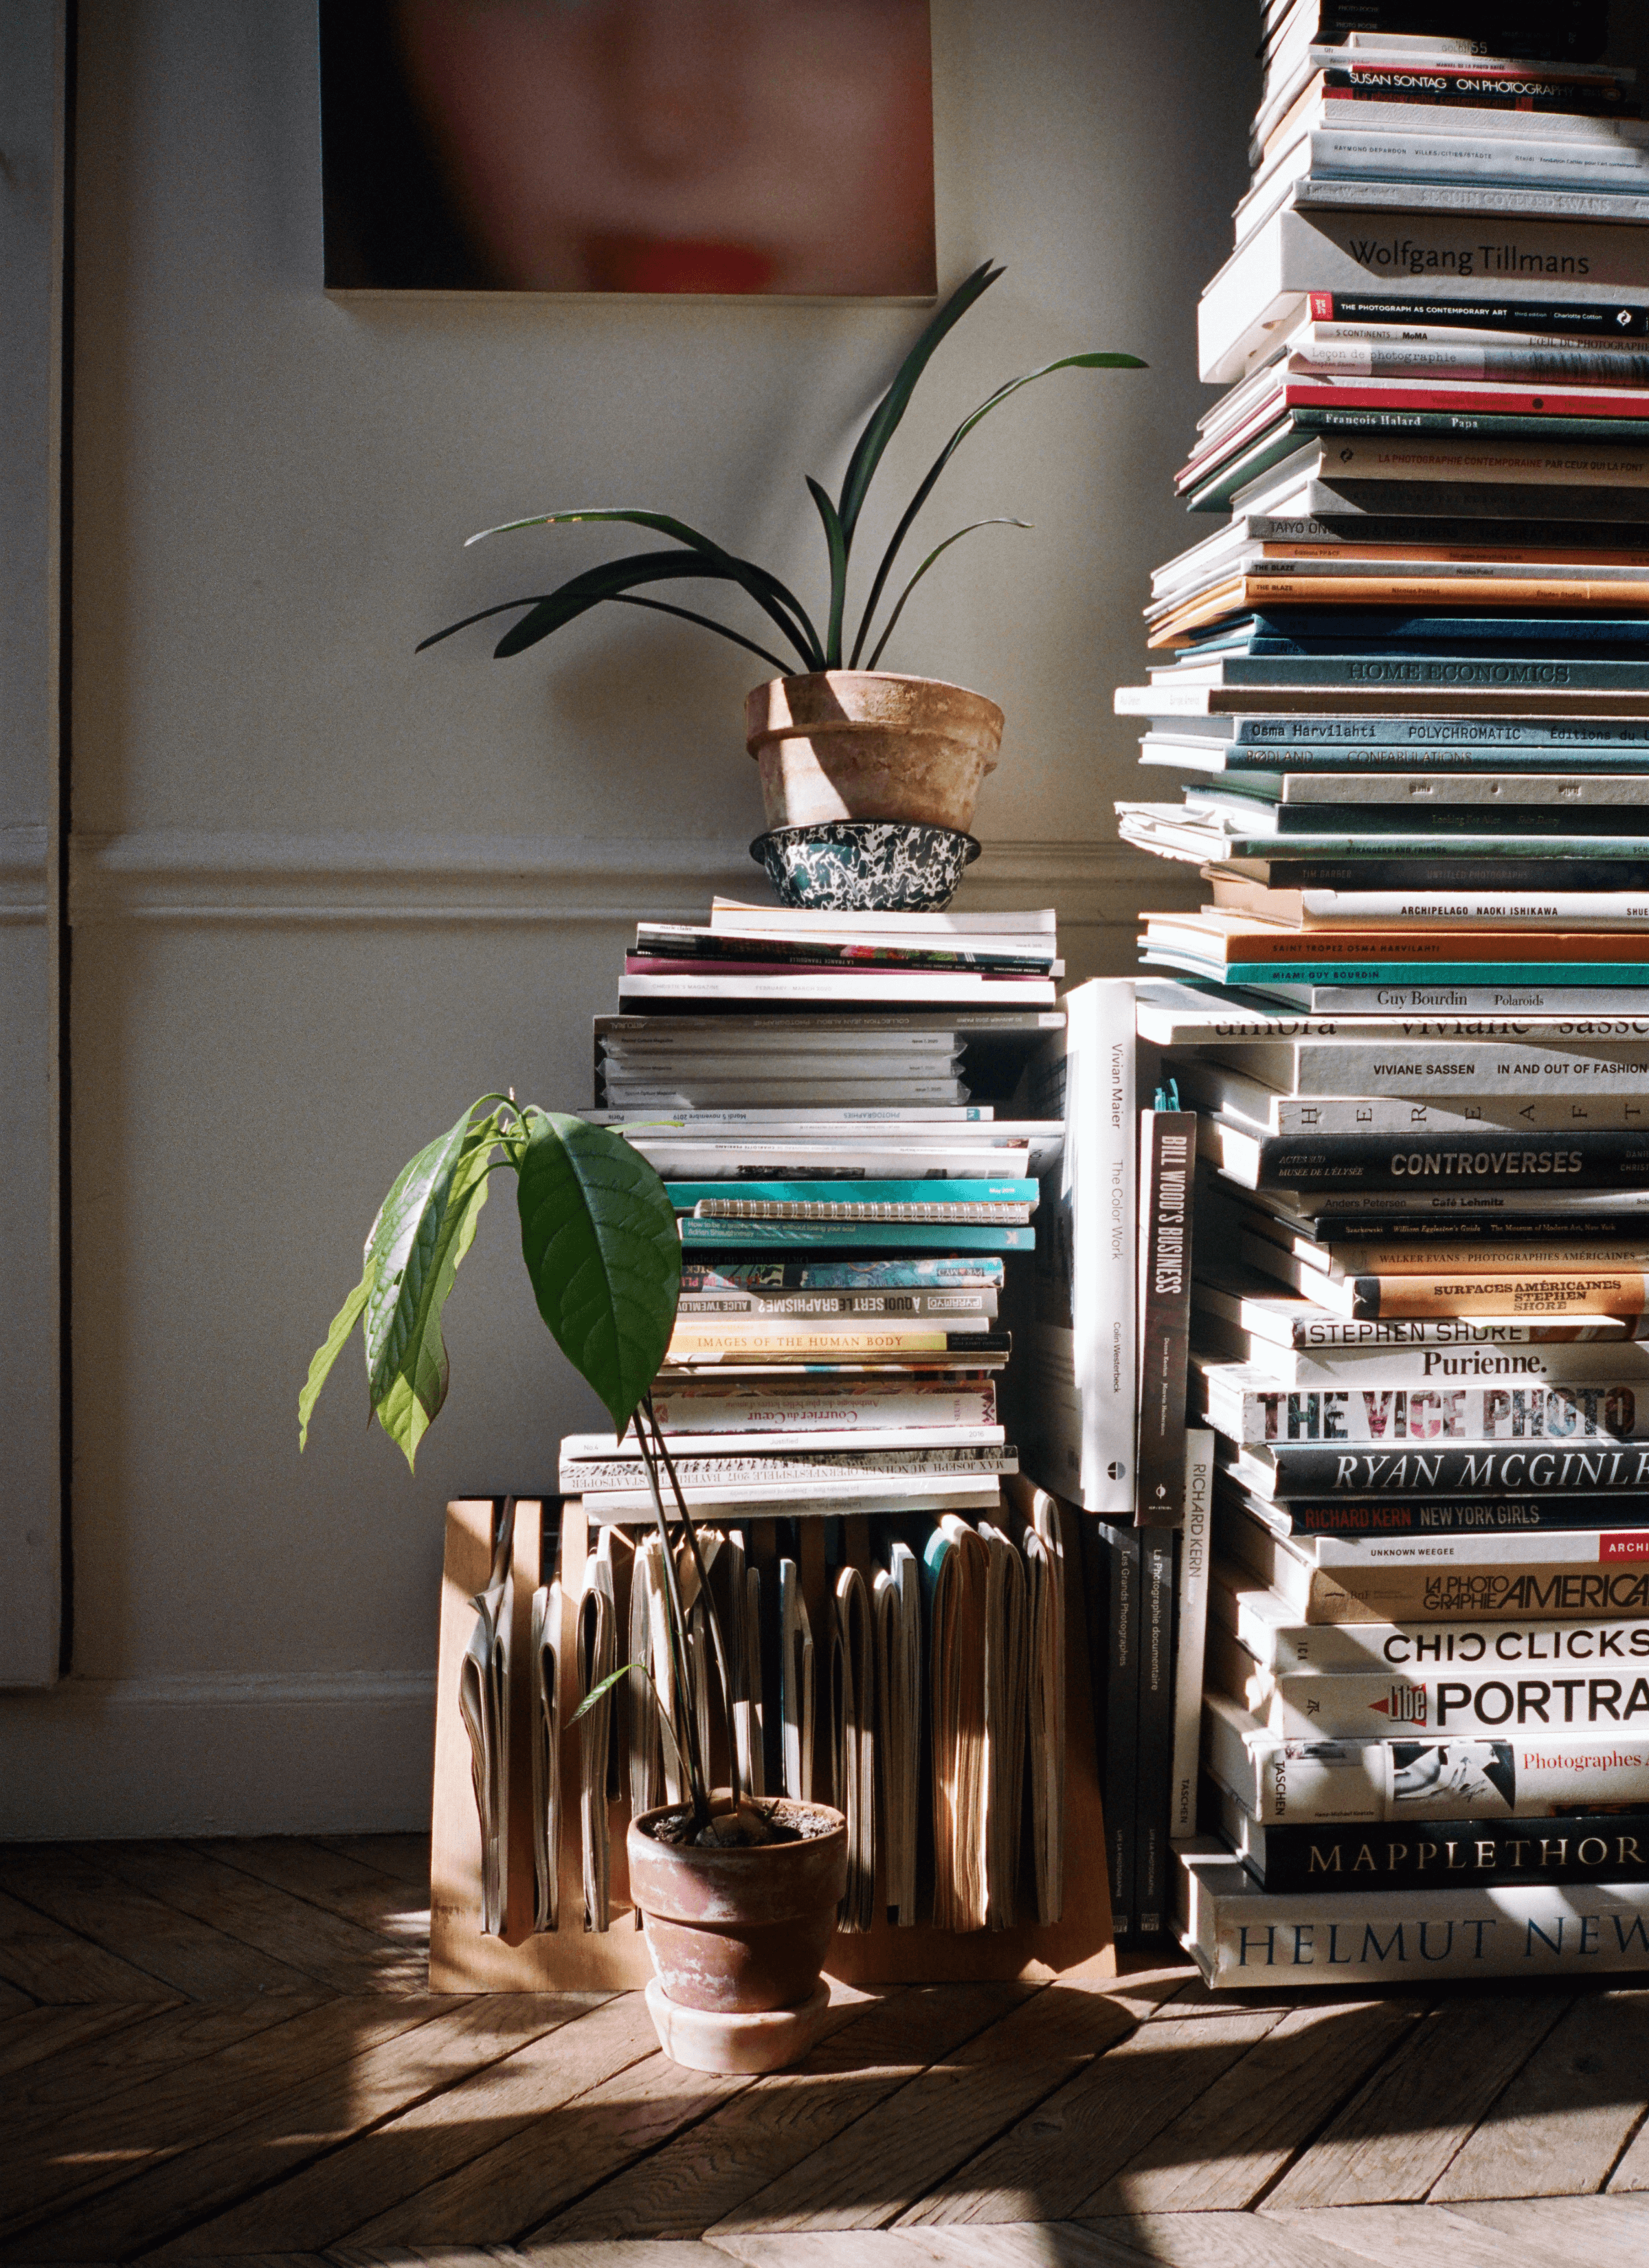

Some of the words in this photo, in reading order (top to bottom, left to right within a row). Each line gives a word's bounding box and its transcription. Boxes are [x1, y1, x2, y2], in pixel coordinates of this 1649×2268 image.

[1349, 72, 1391, 87] SUSAN
[1393, 75, 1446, 89] SONTAG
[1456, 78, 1480, 91] ON
[1482, 80, 1575, 97] PHOTOGRAPHY
[1349, 239, 1473, 275] Wolfgang
[1479, 246, 1590, 275] Tillmans
[1358, 304, 1411, 313] PHOTOGRAPH
[1426, 307, 1490, 315] CONTEMPORARY
[1312, 348, 1347, 361] Leçon
[1351, 349, 1365, 359] de
[1370, 350, 1457, 364] photographie
[1325, 414, 1376, 426] François
[1380, 414, 1422, 427] Halard
[1451, 416, 1479, 429] Papa
[1378, 454, 1390, 463] LA
[1391, 454, 1463, 466] PHOTOGRAPHIE
[1463, 456, 1543, 468] CONTEMPORAINE
[1545, 459, 1562, 469] PAR
[1564, 460, 1589, 470] CEUX
[1590, 460, 1604, 471] QUI
[1606, 461, 1618, 471] LA
[1619, 461, 1644, 472] FONT
[1270, 521, 1305, 534] TAIYO
[1346, 662, 1420, 680] HOME
[1425, 664, 1570, 683] ECONOMICS
[1251, 724, 1286, 737] Osma
[1293, 724, 1377, 738] Harvilahti
[1407, 726, 1522, 741] POLYCHROMATIC
[1550, 724, 1611, 741] Éditions
[1619, 729, 1637, 740] du
[1246, 751, 1314, 764] RØDLAND
[1347, 751, 1472, 764] CONFABULATIONS
[1400, 906, 1469, 915] ARCHIPELAGO
[1477, 906, 1506, 915] NAOKI
[1510, 907, 1558, 916] ISHIKAWA
[1626, 907, 1649, 916] SHUE
[1272, 944, 1303, 953] SAINT
[1305, 944, 1343, 953] TROPEZ
[1347, 944, 1376, 953] OSMA
[1380, 944, 1440, 953] HARVILAHTI
[1272, 971, 1305, 979] MIAMI
[1308, 971, 1330, 979] GUY
[1333, 970, 1380, 979] BOURDIN
[1377, 990, 1407, 1010] Guy
[1411, 990, 1468, 1006] Bourdin
[1494, 994, 1545, 1006] Polaroids
[1111, 1043, 1123, 1085] Vivian
[1373, 1064, 1423, 1076] VIVIANE
[1425, 1064, 1475, 1075] SASSEN
[1497, 1064, 1512, 1074] IN
[1514, 1063, 1540, 1074] AND
[1544, 1063, 1569, 1074] OUT
[1573, 1063, 1591, 1074] OF
[1593, 1063, 1648, 1074] FASHION
[1111, 1087, 1123, 1129] Maier
[1160, 1135, 1187, 1166] BILL
[1112, 1159, 1124, 1185] The
[1391, 1150, 1583, 1176] CONTROVERSES
[1111, 1188, 1124, 1221] Color
[1158, 1170, 1187, 1224] WOOD'S
[1111, 1223, 1124, 1260] Work
[1155, 1226, 1184, 1293] BUSINESS
[1380, 1252, 1424, 1264] WALKER
[1425, 1252, 1463, 1263] EVANS
[1468, 1252, 1560, 1263] PHOTOGRAPHIES
[1562, 1249, 1636, 1261] AMÉRICAINES
[1434, 1284, 1512, 1296] SURFACES
[1514, 1280, 1622, 1292] AMÉRICAINES
[1514, 1291, 1586, 1302] STEPHEN
[722, 1300, 748, 1311] ALICE
[758, 1298, 839, 1312] GRAPHISME?
[838, 1298, 853, 1311] LE
[853, 1298, 884, 1311] SERT
[884, 1296, 912, 1311] QUOI
[912, 1296, 921, 1314] À
[929, 1298, 980, 1308] PYRAMYD
[1514, 1301, 1567, 1311] SHORE
[1113, 1322, 1122, 1342] Colin
[1310, 1323, 1425, 1344] STEPHEN
[1436, 1323, 1523, 1341] SHORE
[697, 1337, 748, 1348] IMAGES
[754, 1337, 773, 1347] OF
[777, 1337, 803, 1347] THE
[808, 1336, 861, 1348] HUMAN
[866, 1335, 904, 1348] BODY
[1112, 1343, 1121, 1393] Westerbeck
[1422, 1350, 1548, 1376] Purienne.
[747, 1411, 786, 1425] Cœur
[786, 1411, 800, 1421] du
[800, 1410, 858, 1423] Courrier
[1257, 1392, 1349, 1439] THE
[1362, 1390, 1466, 1439] VICE
[1483, 1386, 1636, 1438] PHOTO
[752, 1467, 859, 1480] OPERNFESTSPIELE
[861, 1463, 927, 1476] MÜNCHNER
[933, 1461, 976, 1472] JOSEPH
[978, 1460, 1005, 1469] MAX
[1332, 1454, 1444, 1490] RYAN
[1454, 1451, 1649, 1489] MCGINLE
[572, 1478, 645, 1488] STAATSOPER
[728, 1473, 750, 1482] 2017
[1190, 1463, 1207, 1535] RICHARD
[1305, 1508, 1369, 1528] RICHARD
[1373, 1507, 1411, 1526] KERN
[1420, 1507, 1452, 1526] NEW
[1453, 1506, 1494, 1525] YORK
[1496, 1505, 1540, 1524] GIRLS
[1154, 1548, 1163, 1561] La
[1371, 1548, 1416, 1557] UNKNOWN
[1417, 1548, 1455, 1556] WEEGEE
[1609, 1542, 1649, 1553] ARCHI
[1121, 1550, 1131, 1566] Les
[1189, 1538, 1203, 1578] KERN
[1121, 1568, 1130, 1601] Grands
[1149, 1562, 1163, 1625] Photographie
[1426, 1576, 1442, 1594] LA
[1446, 1575, 1510, 1594] PHOTO
[1496, 1573, 1649, 1609] AMERICA
[1423, 1593, 1500, 1610] GRAPHIE
[1118, 1603, 1130, 1666] Photographes
[1495, 1629, 1649, 1660] CLICKS
[1150, 1626, 1161, 1691] documentaire
[1437, 1678, 1649, 1727] PORTRA
[1523, 1750, 1641, 1772] Photographes
[1275, 1761, 1286, 1816] TASCHEN
[1179, 1778, 1190, 1824] TASCHEN
[1308, 1836, 1648, 1874] MAPPLETHOR
[1237, 1919, 1496, 1967] HELMUT
